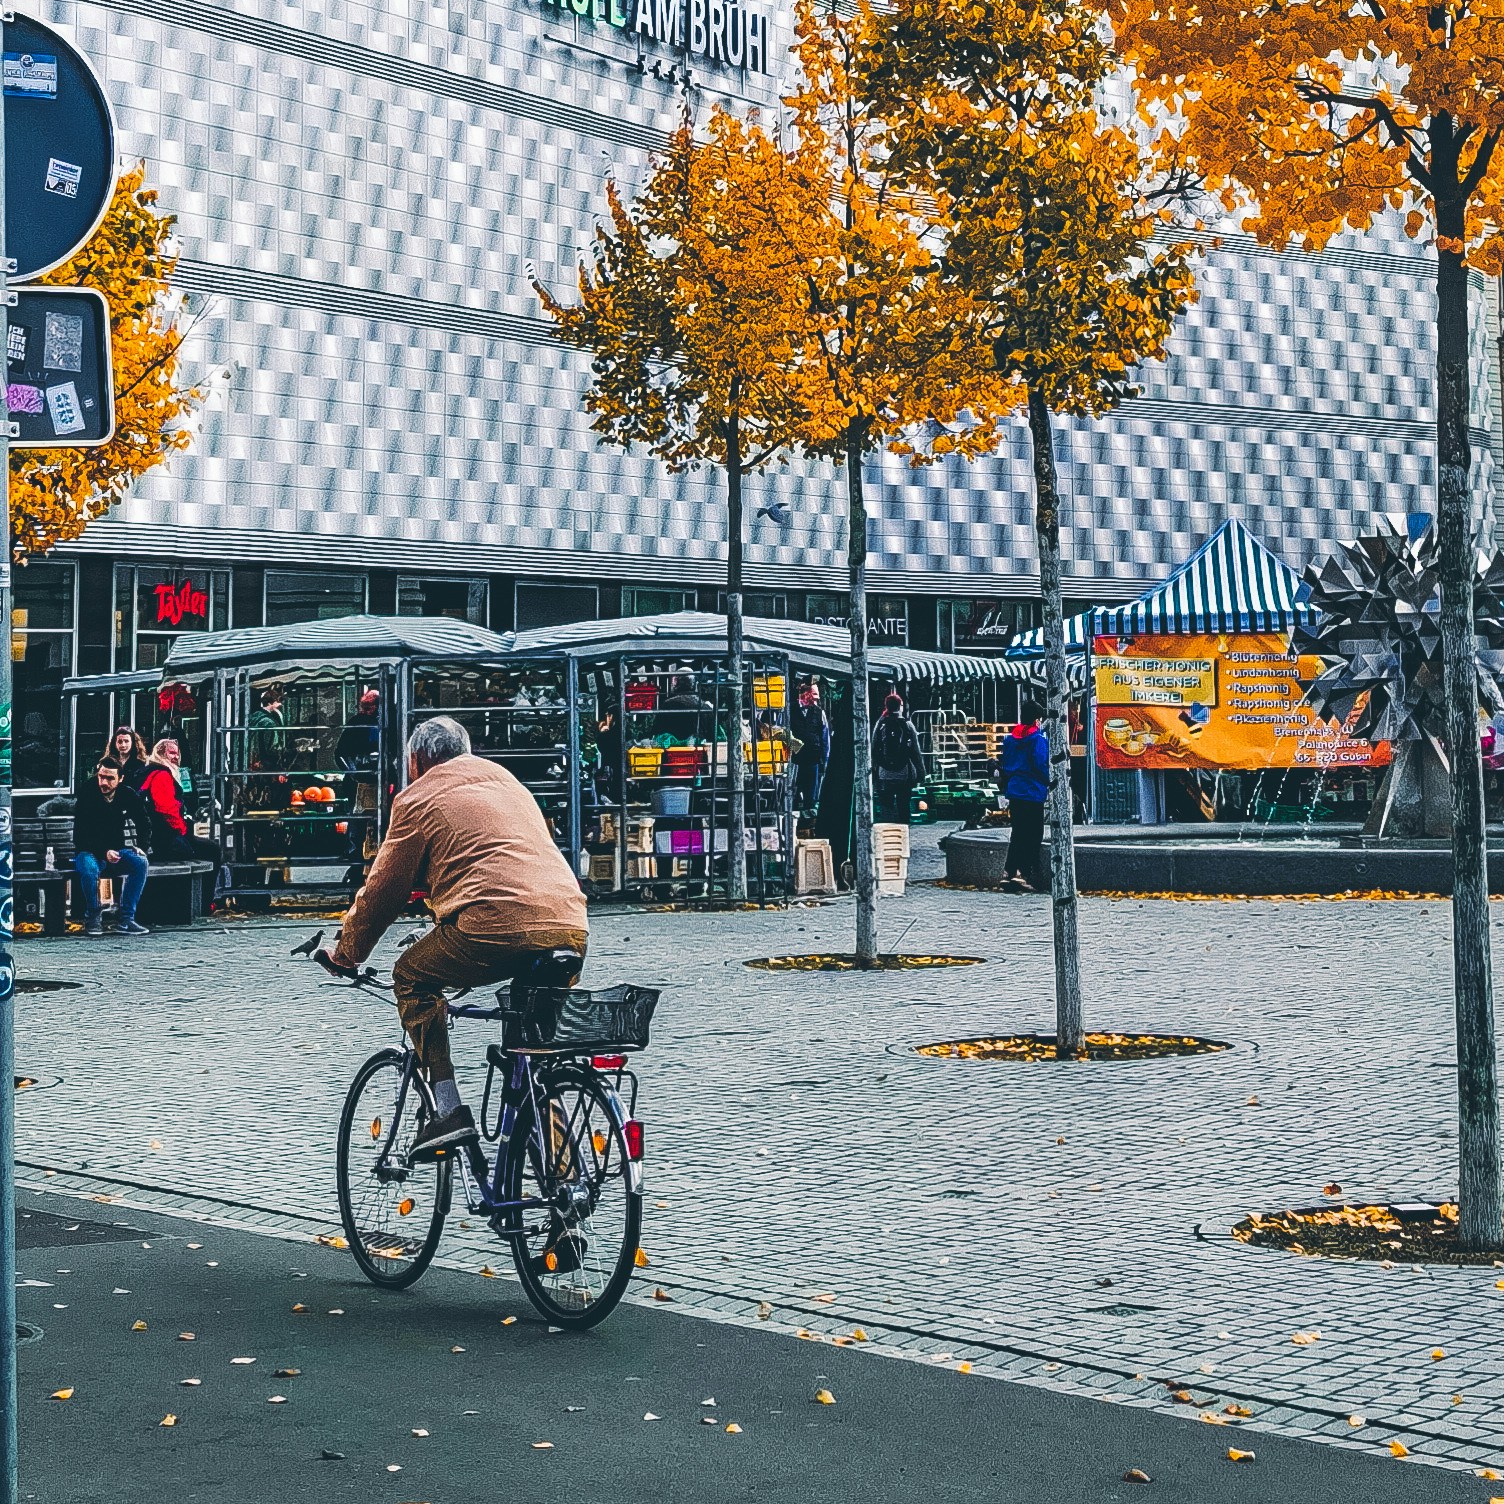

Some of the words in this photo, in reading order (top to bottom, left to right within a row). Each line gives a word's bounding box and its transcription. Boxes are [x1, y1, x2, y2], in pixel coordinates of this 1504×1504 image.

[1099, 658, 1162, 672] FRISCHER
[1165, 660, 1212, 672] HONIG
[1113, 674, 1140, 686] AUS
[1143, 676, 1201, 689] EIGENER
[1234, 683, 1289, 695] Rapshonig
